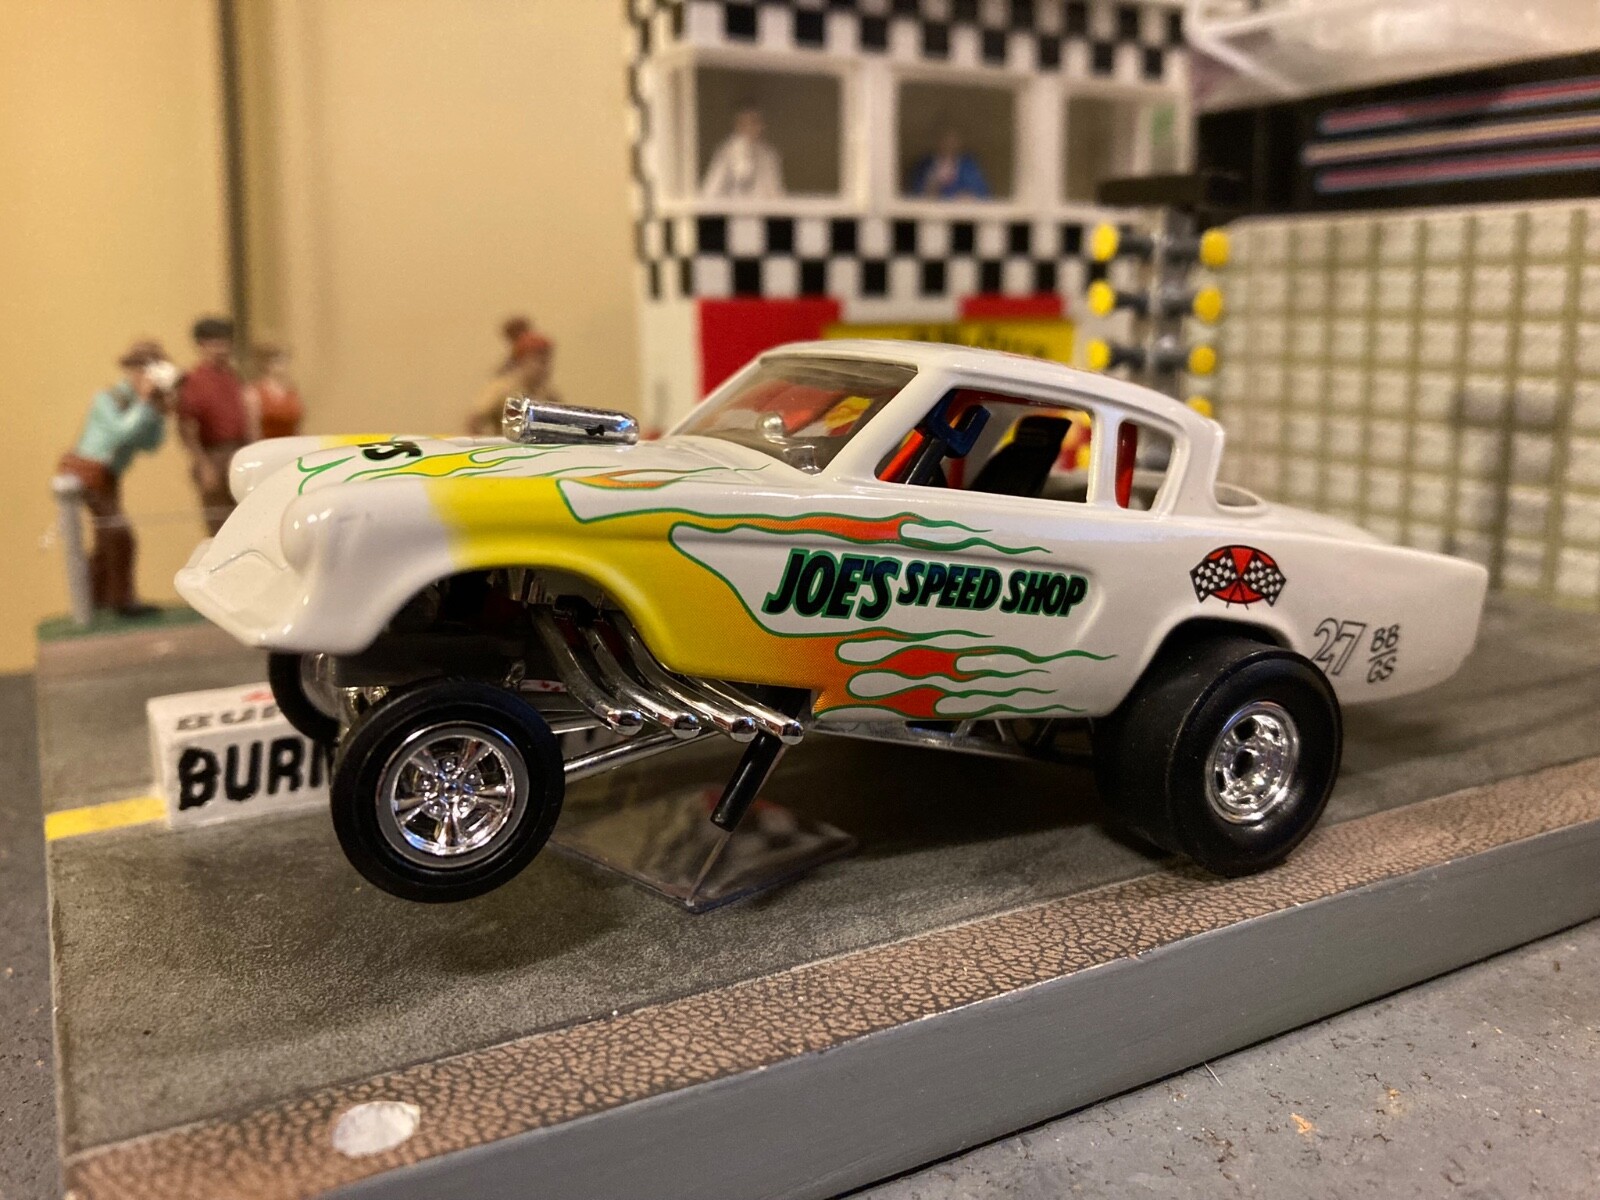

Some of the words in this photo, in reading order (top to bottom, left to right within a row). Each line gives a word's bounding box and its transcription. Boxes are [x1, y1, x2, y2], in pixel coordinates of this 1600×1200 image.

[761, 548, 903, 621] JOE'S
[896, 560, 1003, 611] SPEED
[999, 569, 1088, 617] SHOP
[1310, 617, 1367, 676] 27
